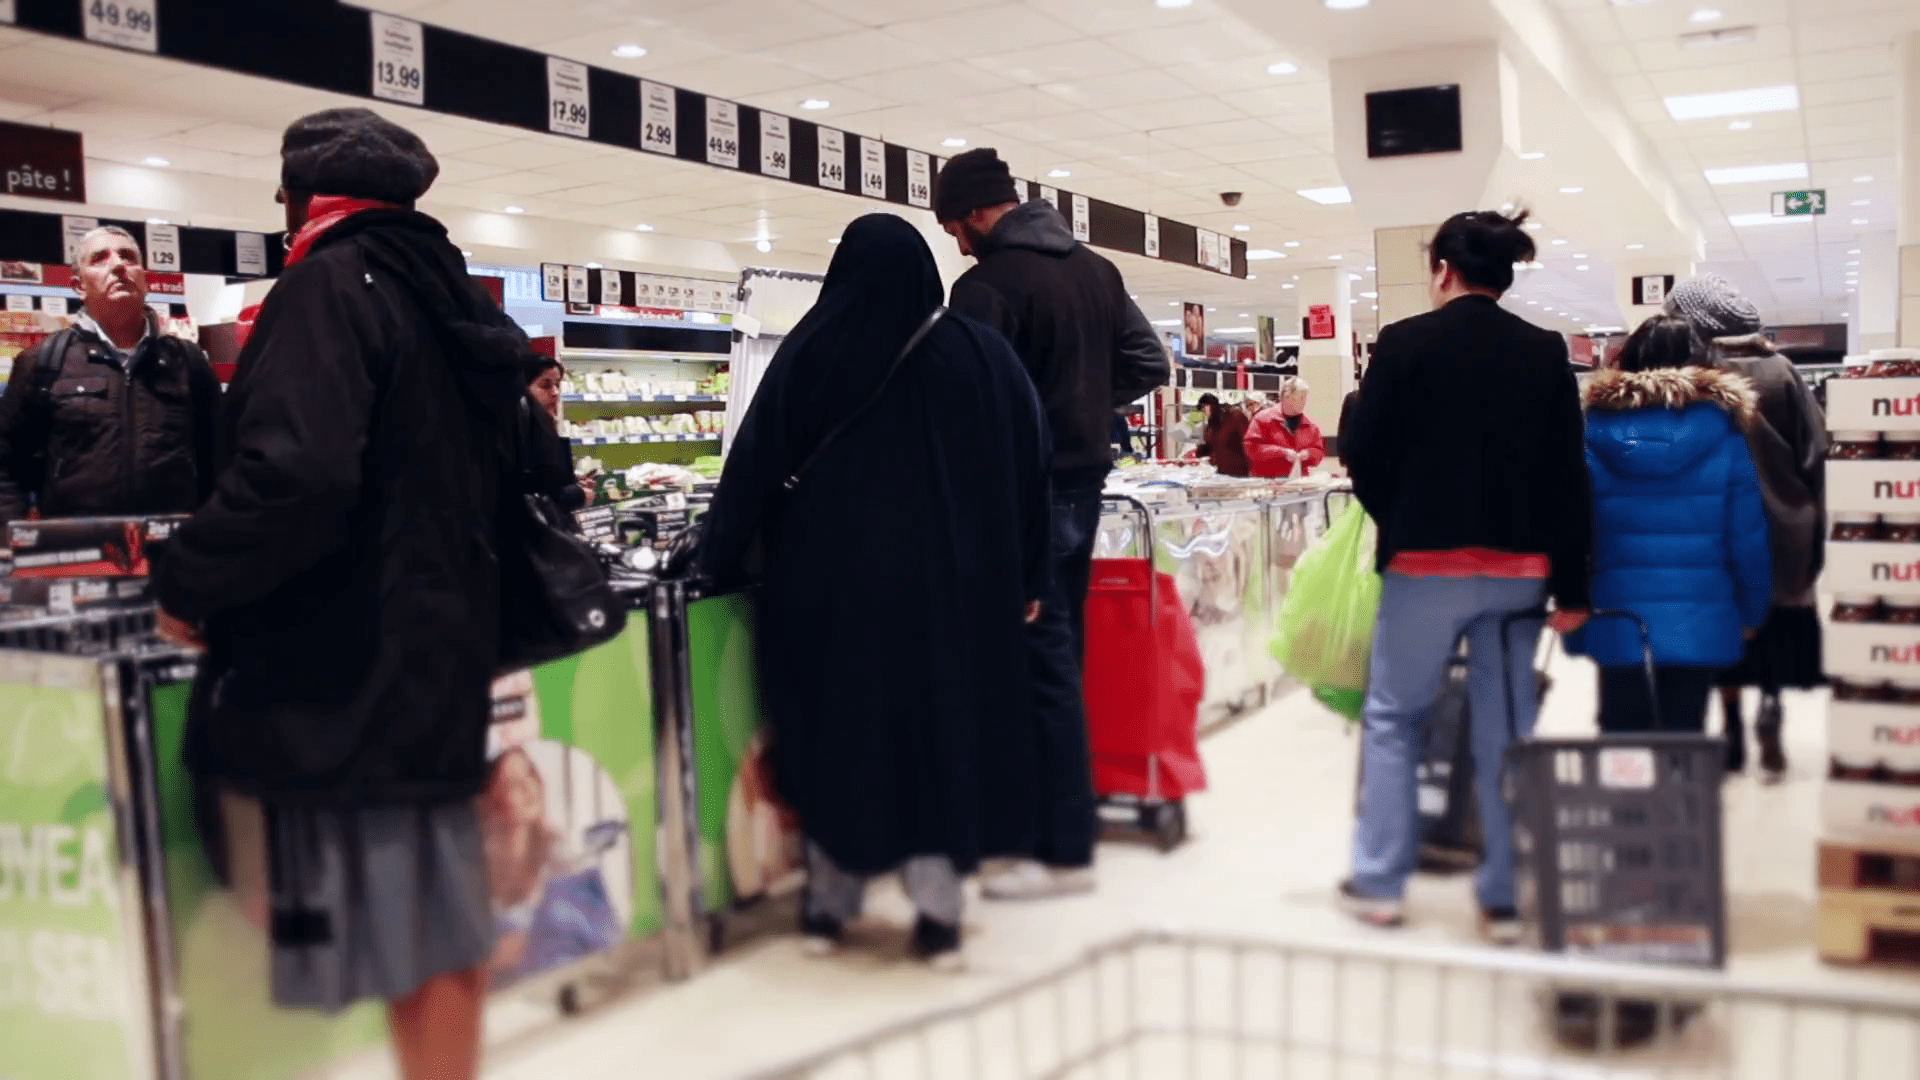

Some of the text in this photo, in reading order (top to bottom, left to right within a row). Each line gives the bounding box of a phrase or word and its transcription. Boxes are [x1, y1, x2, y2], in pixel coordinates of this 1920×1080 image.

[89, 0, 152, 33] 49.99
[378, 60, 420, 90] 13.99
[552, 99, 587, 125] 17.99
[645, 122, 672, 145] 2.99
[708, 136, 737, 156] 49.99
[7, 164, 70, 193] pâte !
[821, 161, 842, 182] 2.49
[864, 172, 882, 190] 1.49
[153, 251, 174, 265] 1.29
[1873, 480, 1920, 499] nu
